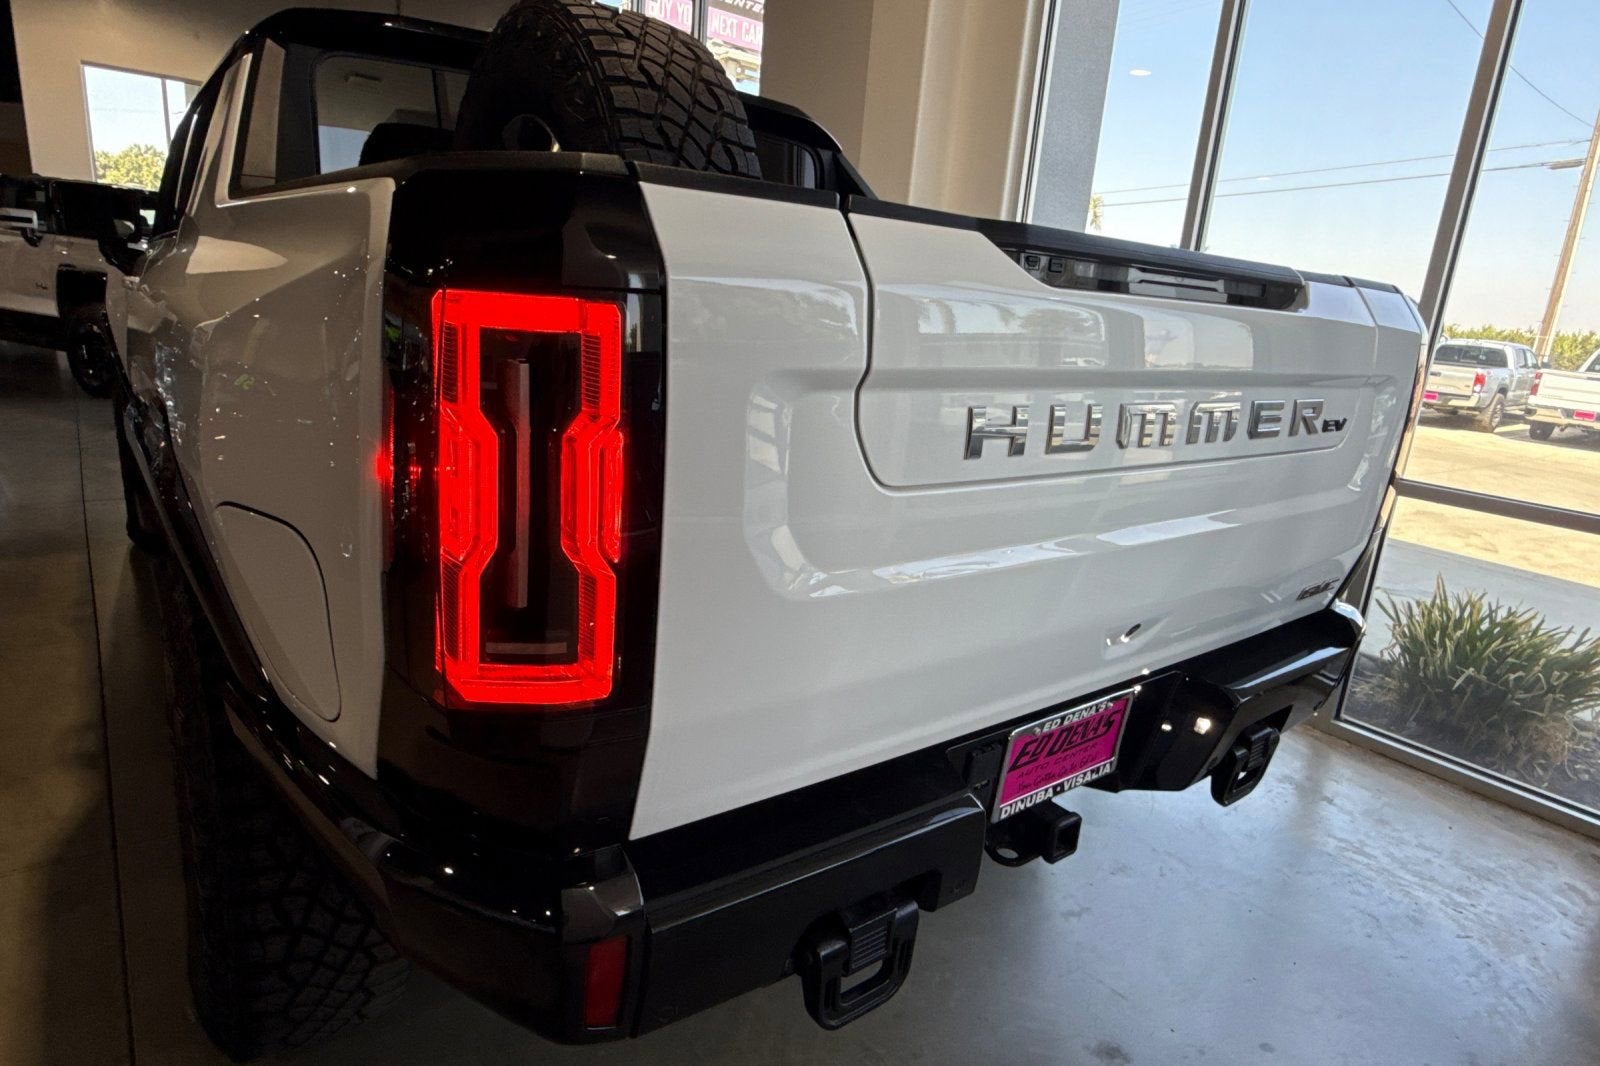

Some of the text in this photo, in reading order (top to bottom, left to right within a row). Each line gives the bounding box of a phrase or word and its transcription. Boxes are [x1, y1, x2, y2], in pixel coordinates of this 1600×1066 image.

[719, 0, 764, 13] ENTE
[712, 13, 738, 38] NEXT
[963, 398, 1348, 460] HUMMER EV
[1042, 700, 1107, 733] ED DENA'S
[1007, 730, 1055, 773] ED
[1016, 761, 1050, 779] AUTO
[1053, 742, 1098, 764] CENTER
[1000, 763, 1111, 820] DINUBA VISALIA
